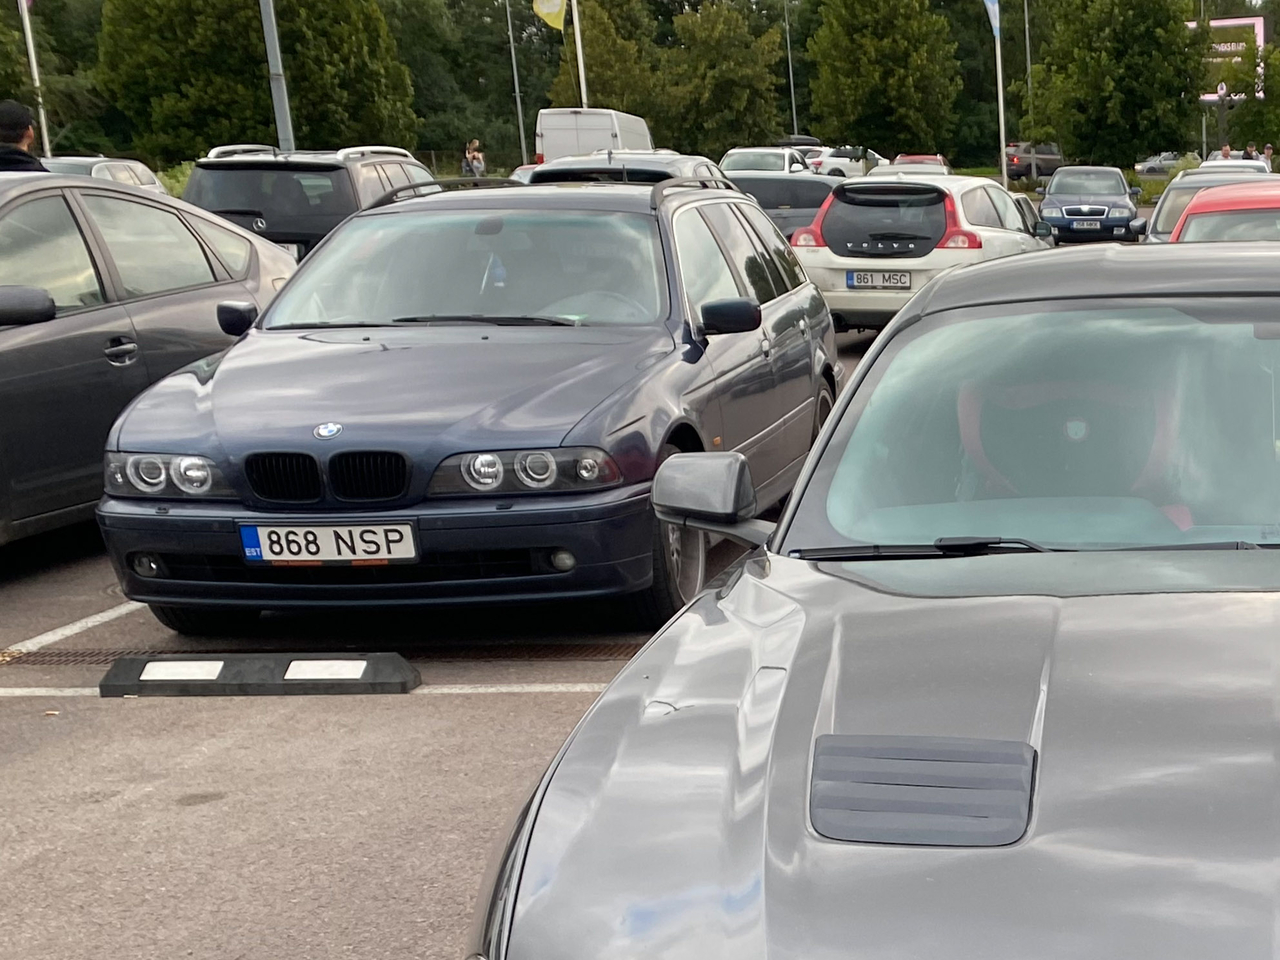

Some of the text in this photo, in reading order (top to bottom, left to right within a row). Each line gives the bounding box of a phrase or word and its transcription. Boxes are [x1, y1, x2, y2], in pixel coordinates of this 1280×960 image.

[856, 273, 907, 284] 861 MSC
[245, 528, 404, 556] EST 868 NSP
